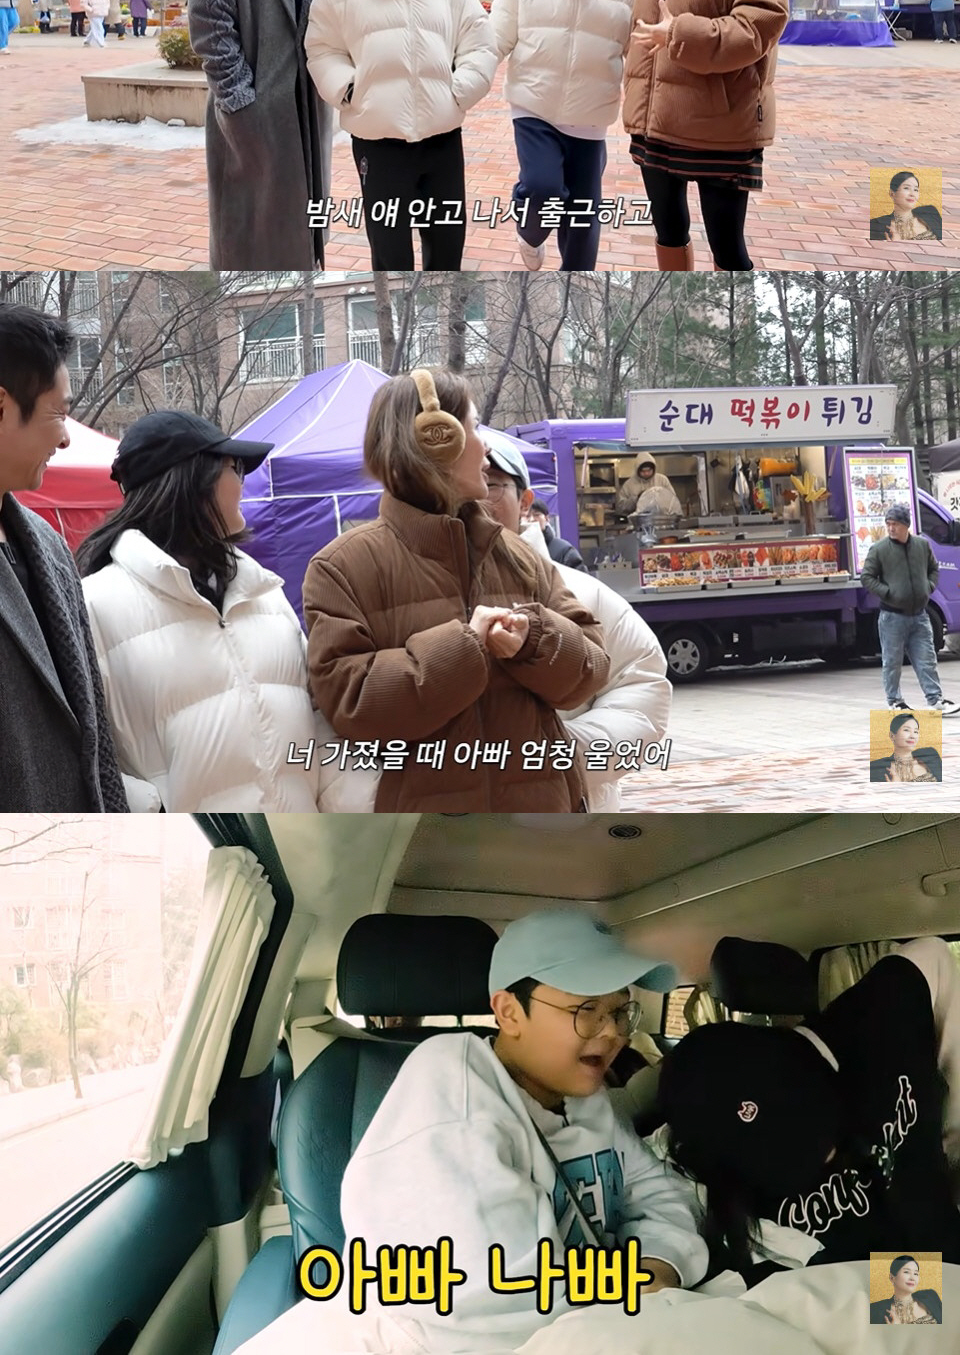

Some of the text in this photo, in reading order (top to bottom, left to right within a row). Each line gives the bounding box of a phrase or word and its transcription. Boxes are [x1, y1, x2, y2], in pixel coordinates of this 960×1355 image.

[659, 395, 873, 432] 순대 떡볶이 튀김
